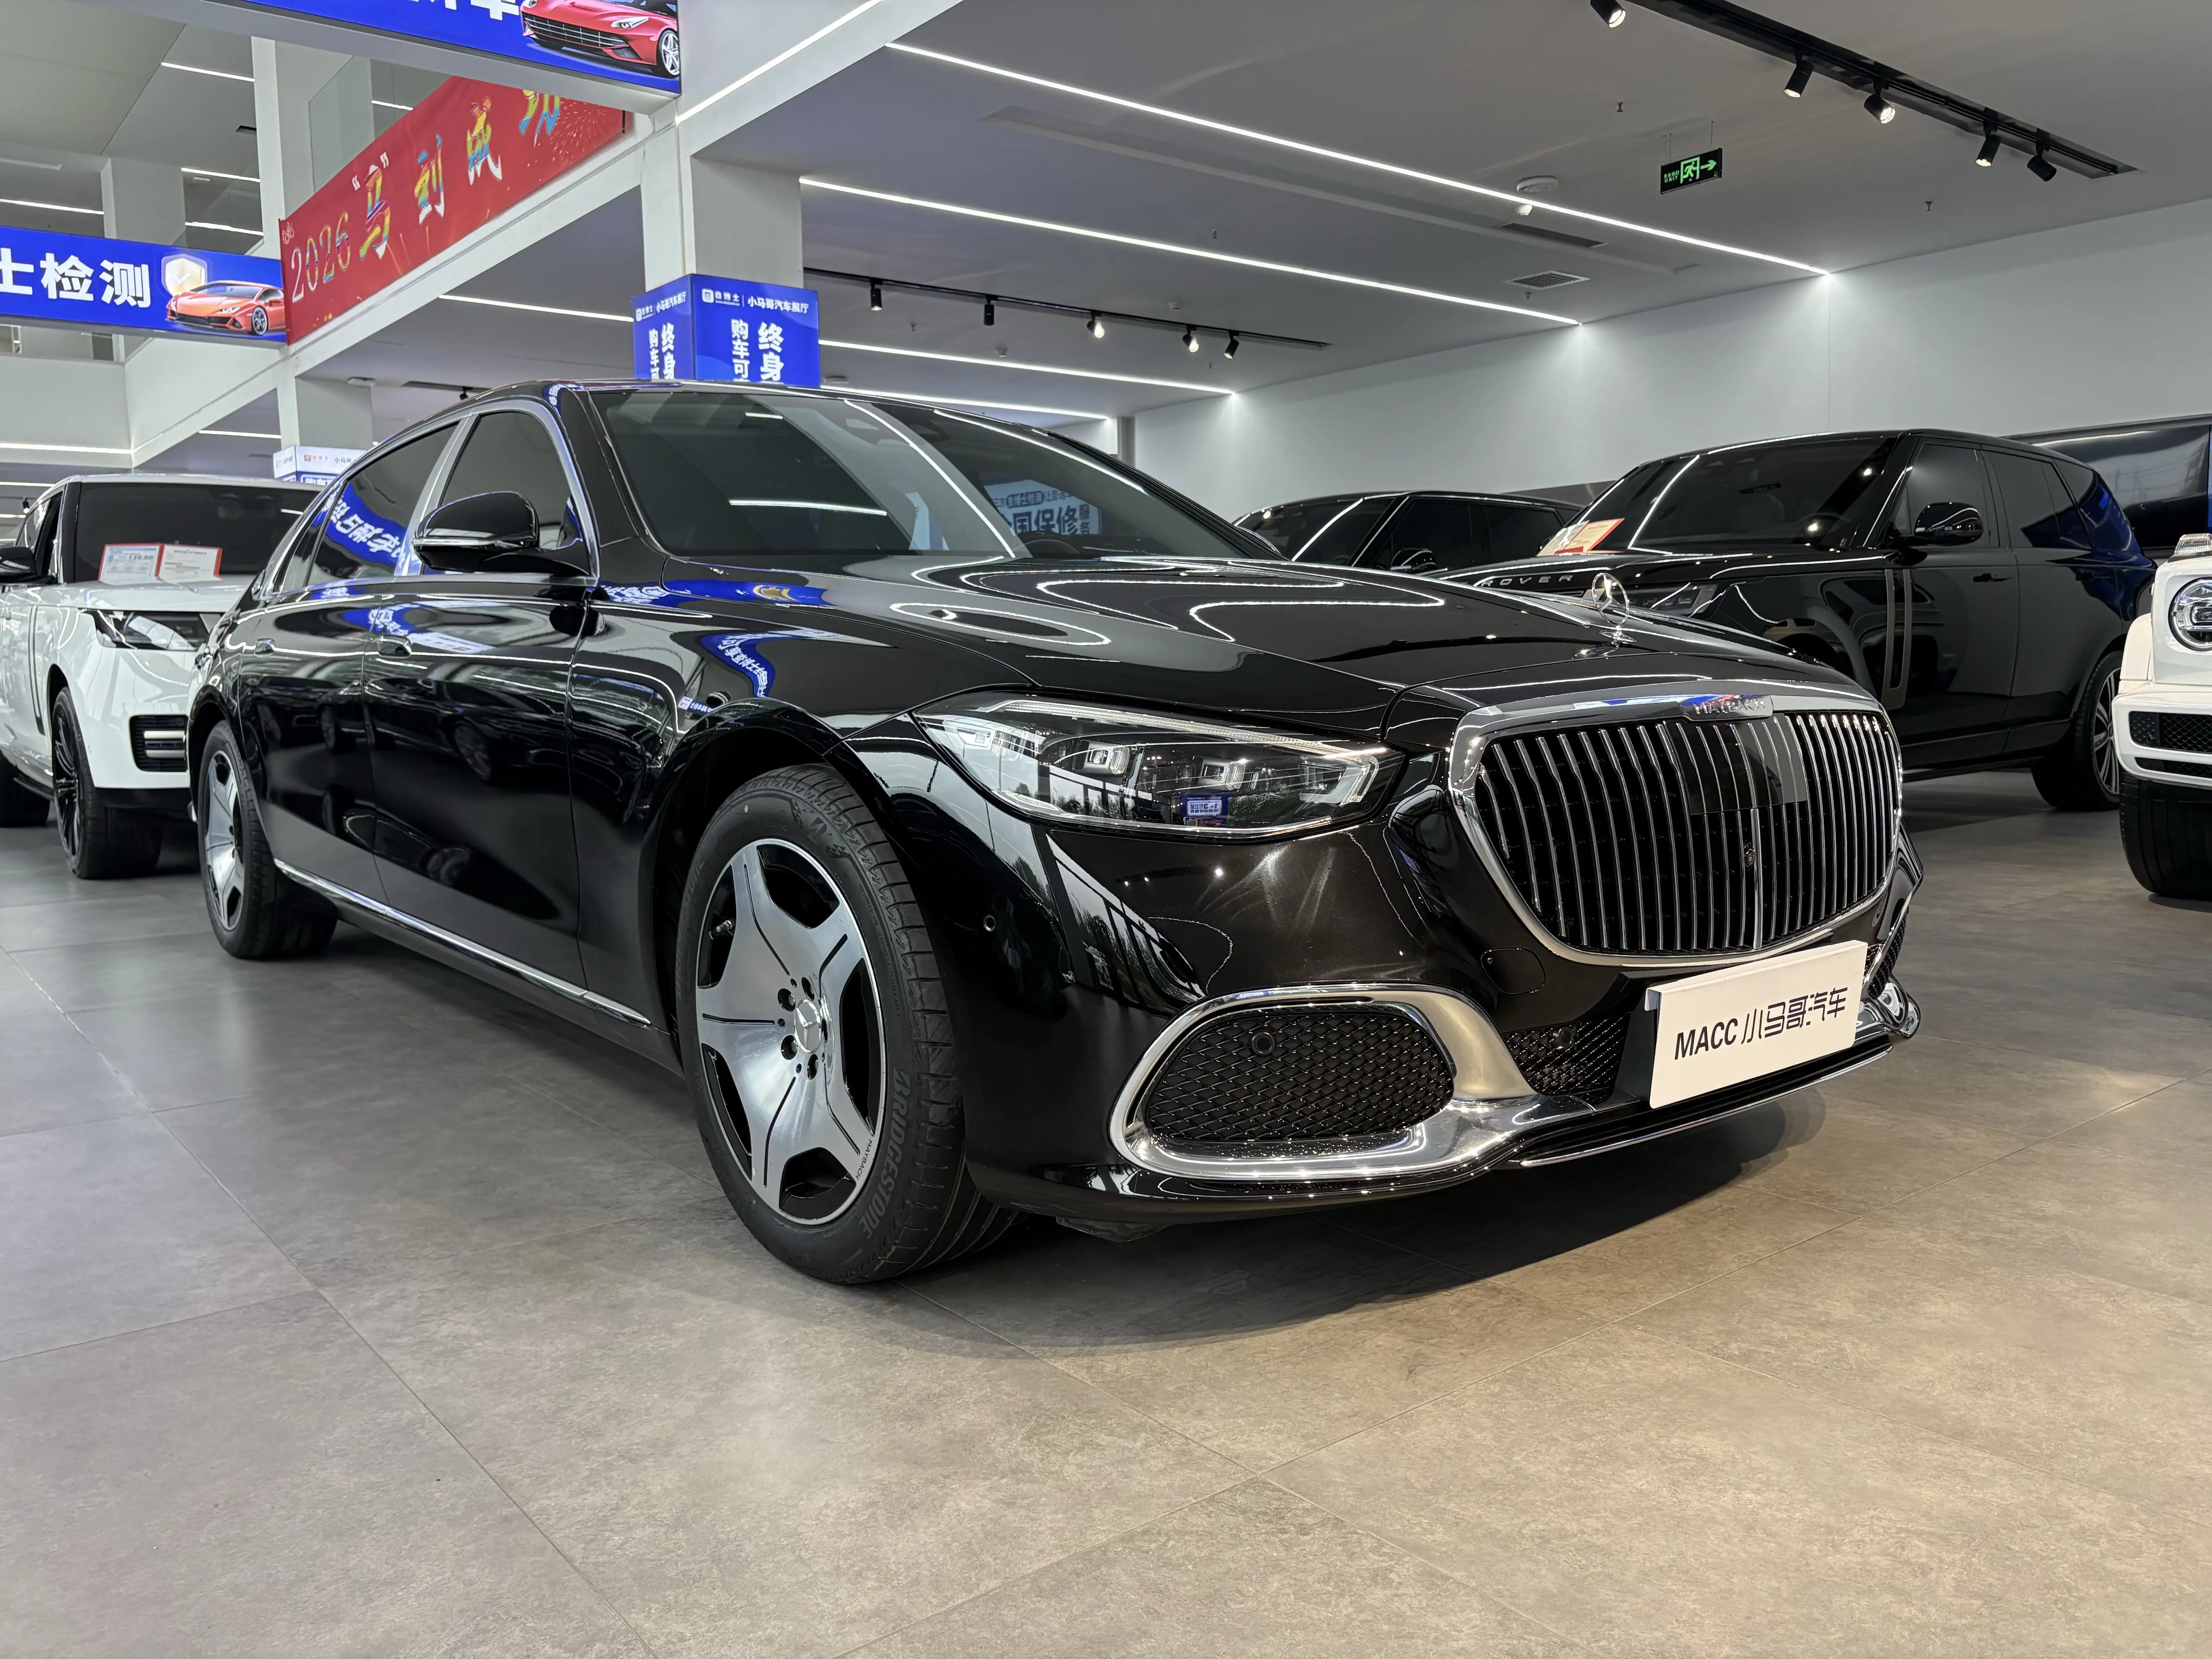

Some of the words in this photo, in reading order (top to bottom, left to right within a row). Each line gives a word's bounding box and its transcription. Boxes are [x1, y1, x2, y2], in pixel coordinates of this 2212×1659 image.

[0, 247, 151, 308] 士检测
[292, 212, 350, 303] 2026
[747, 295, 809, 314] 小马哥汽车展厅
[731, 319, 750, 382] 购车可
[758, 321, 784, 384] 终身
[1004, 505, 1079, 534] 国保修
[1481, 575, 1573, 586] ROVER
[1692, 698, 1766, 714] MAYBACH
[1674, 1018, 1738, 1060] MACC
[1741, 987, 1848, 1045] 小马哥汽车
[855, 1139, 872, 1180] MAYBACH
[859, 1066, 910, 1239] BRIDGESTONE
